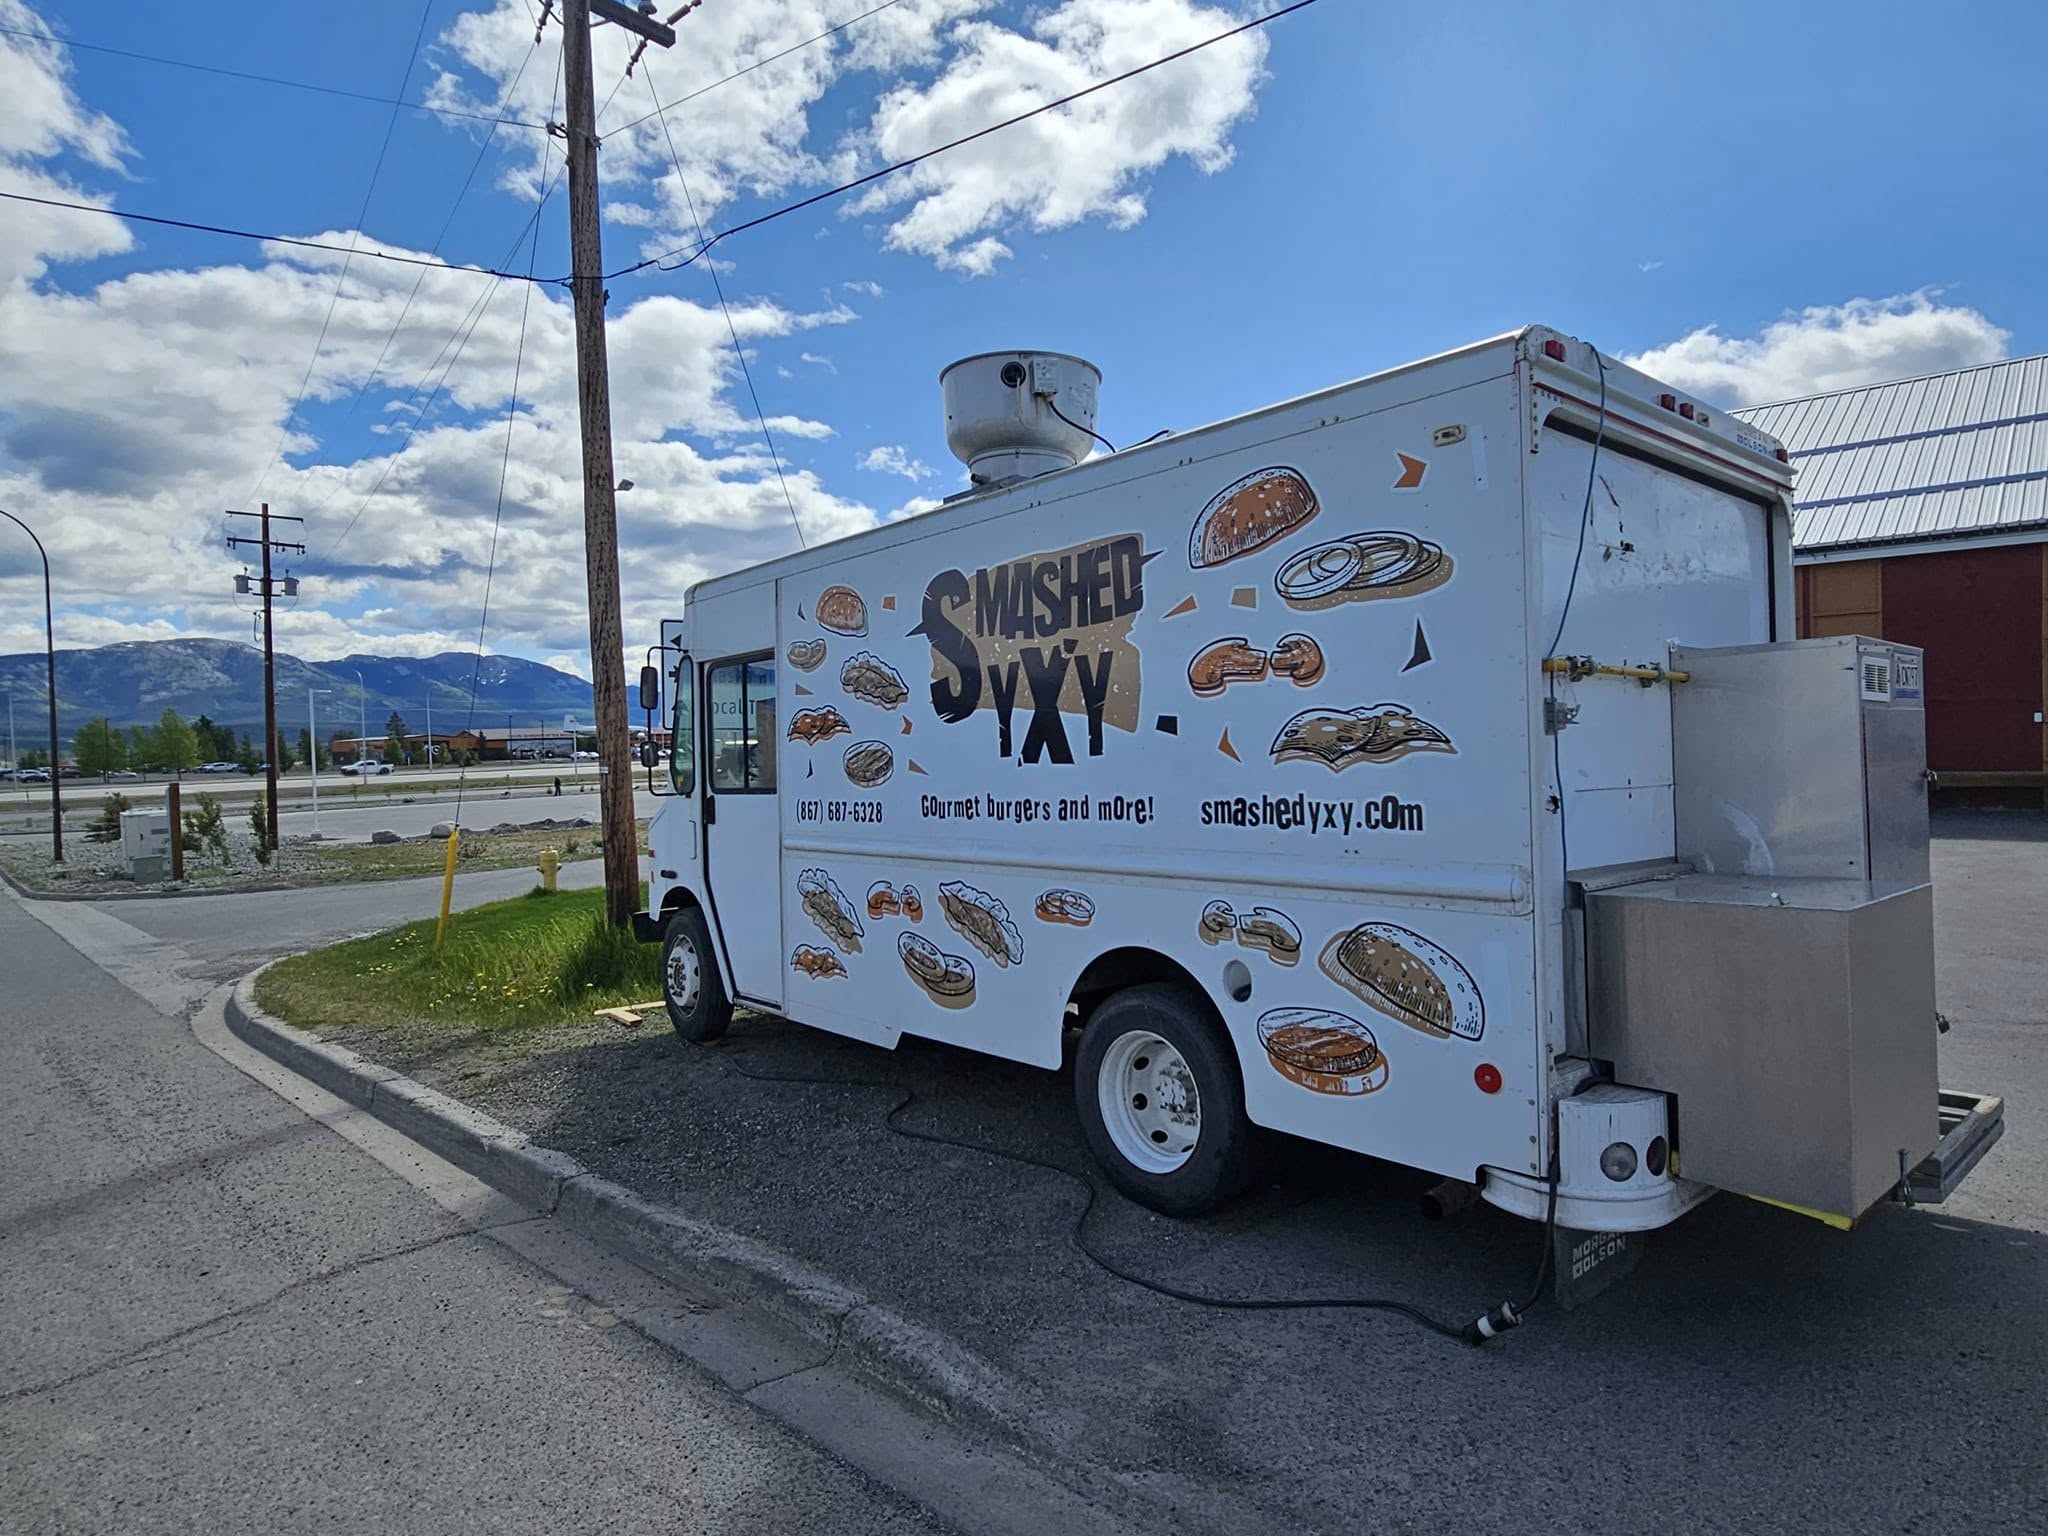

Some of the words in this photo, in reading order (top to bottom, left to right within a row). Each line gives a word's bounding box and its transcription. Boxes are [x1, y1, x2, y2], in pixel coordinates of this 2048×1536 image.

[921, 536, 1145, 724] SMASHED
[714, 698, 742, 715] ocal
[796, 799, 824, 825] (867)
[828, 801, 883, 823] 687-6328
[921, 794, 981, 820] Gourmet
[987, 793, 1050, 823] burgers
[1058, 795, 1089, 821] and
[1201, 793, 1424, 835] smashedyxy.com
